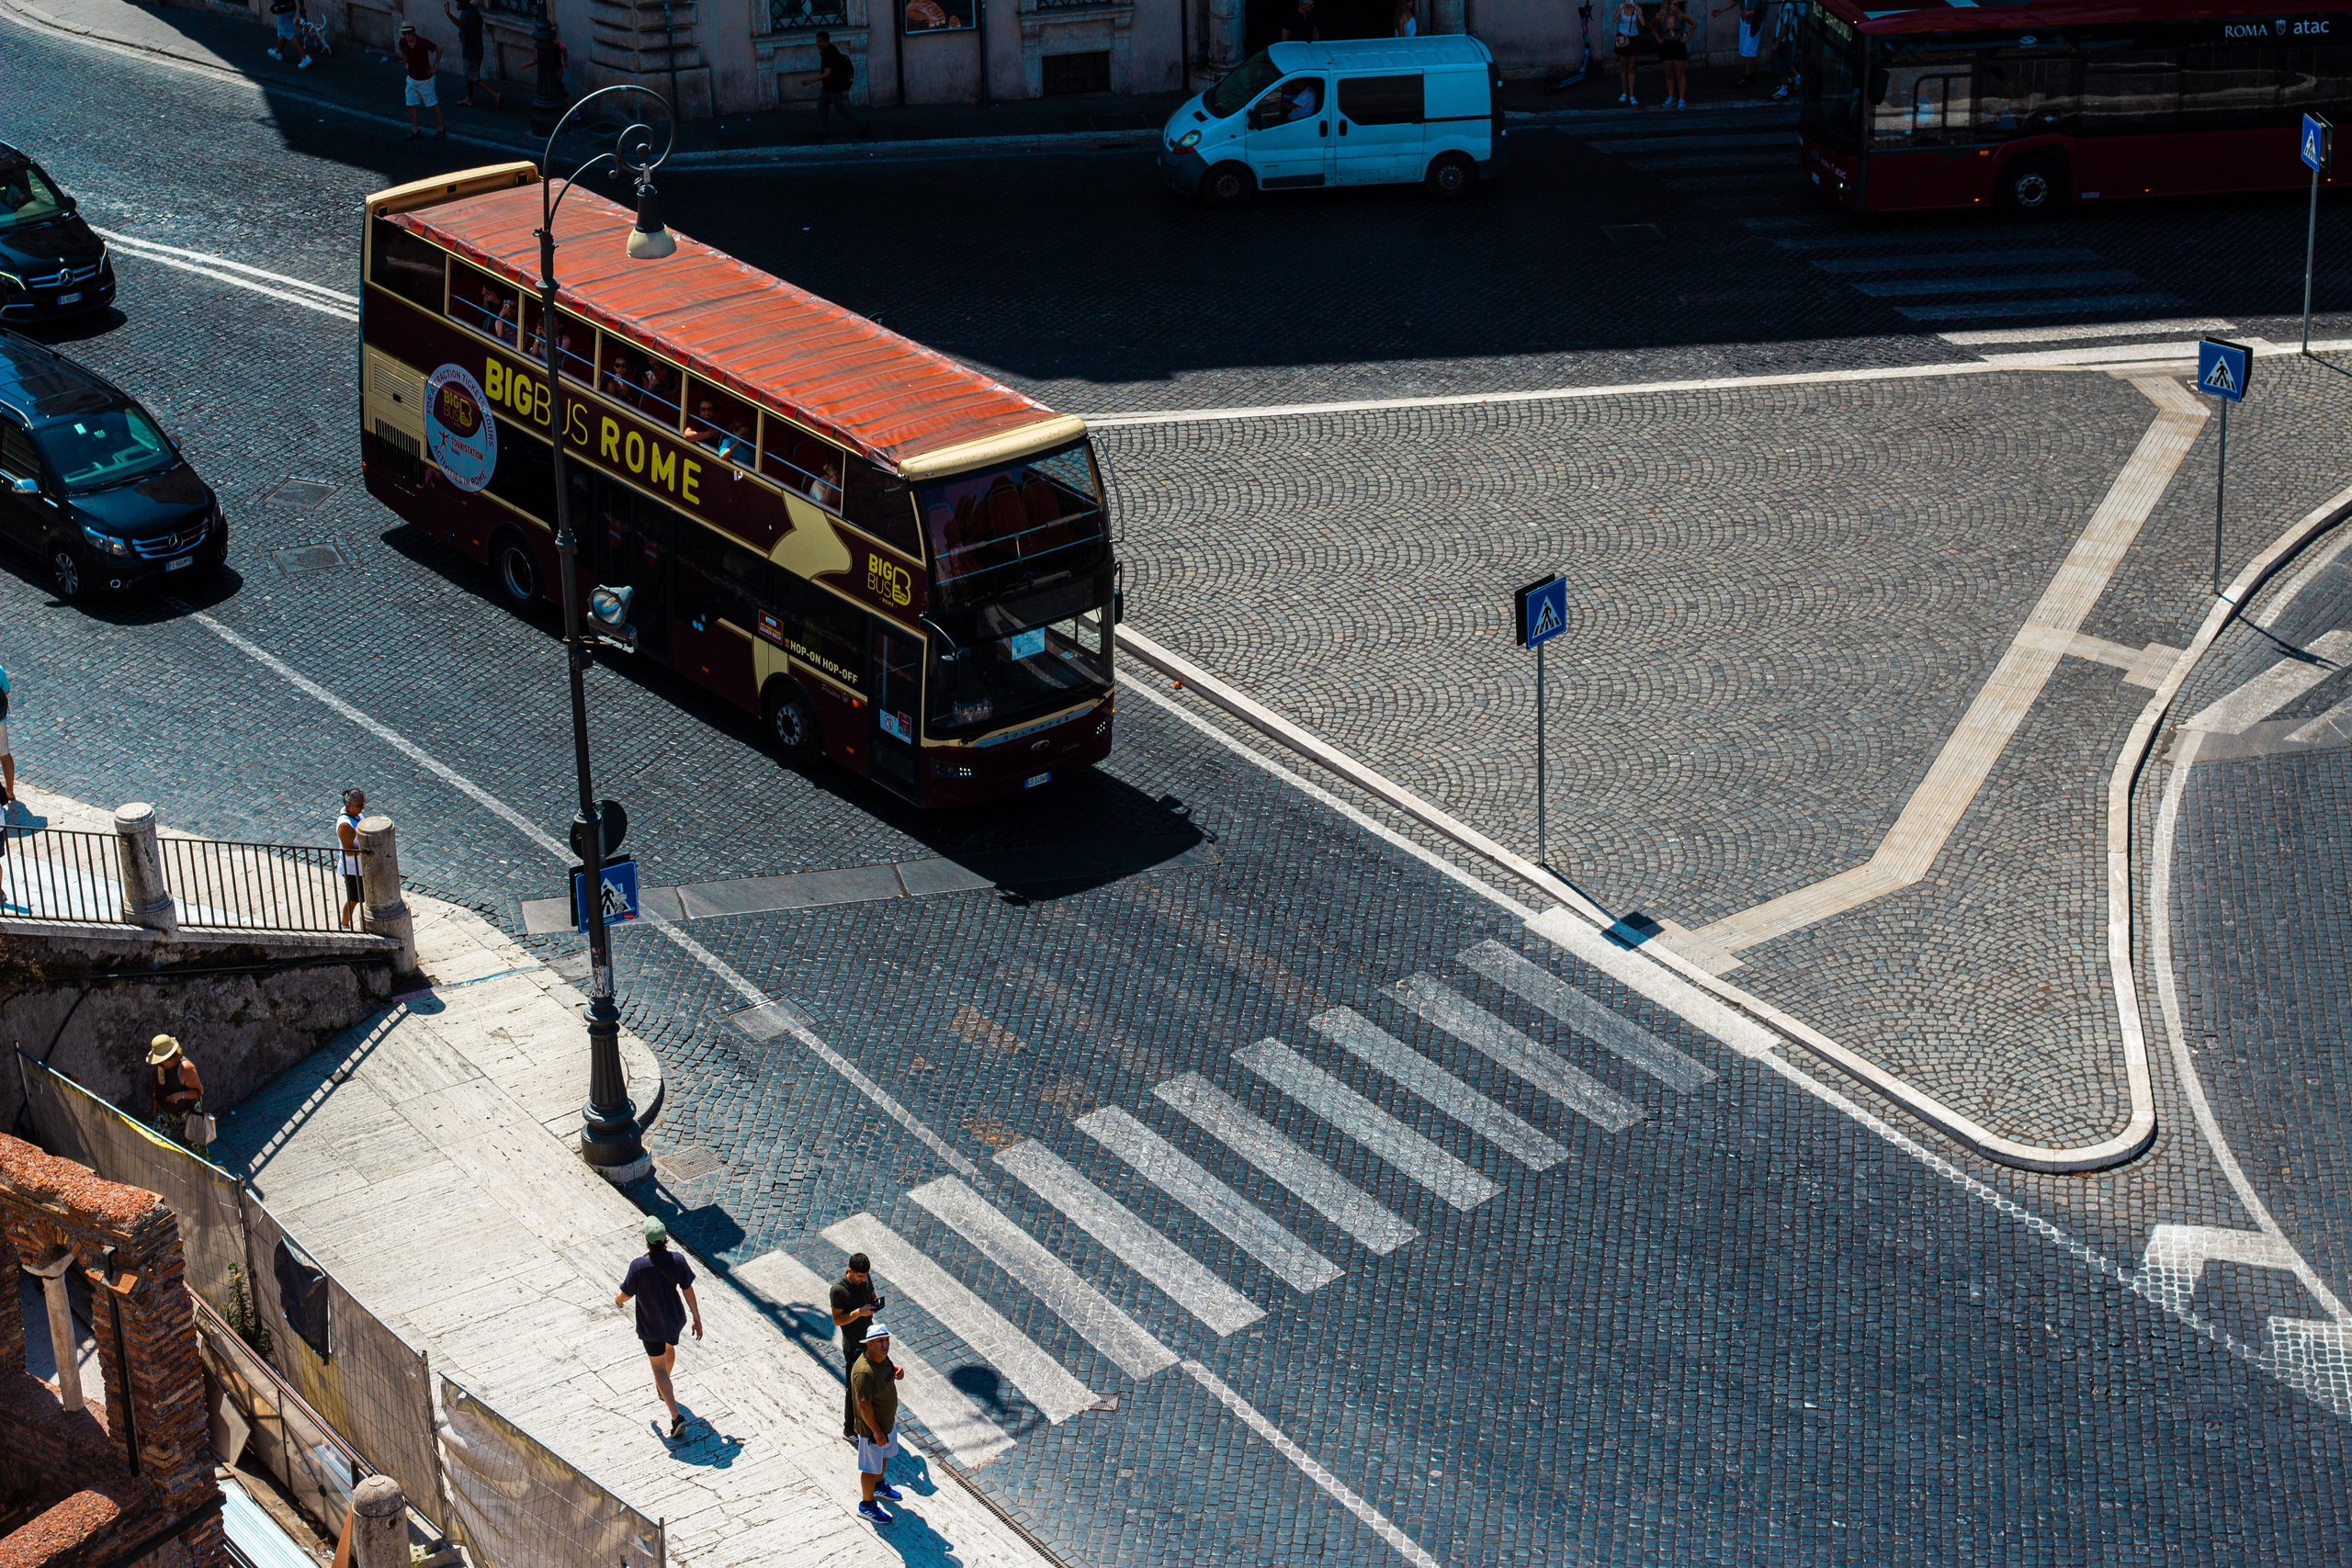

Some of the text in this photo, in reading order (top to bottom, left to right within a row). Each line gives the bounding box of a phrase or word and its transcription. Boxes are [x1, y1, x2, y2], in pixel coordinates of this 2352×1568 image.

[2224, 19, 2330, 38] ROMA atac
[430, 369, 461, 396] ATTRACTION
[484, 412, 494, 447] TOURS
[443, 389, 459, 409] BIG
[443, 403, 459, 423] BUS
[451, 436, 484, 463] TOURISTATION
[600, 415, 702, 505] ROME
[434, 445, 487, 486] ACTIVITIES IN ROME
[868, 552, 893, 581] BIG
[867, 571, 892, 598] BUS
[759, 626, 782, 641] LOWER DECK
[790, 639, 858, 684] HOP-ON HOP-OFF
